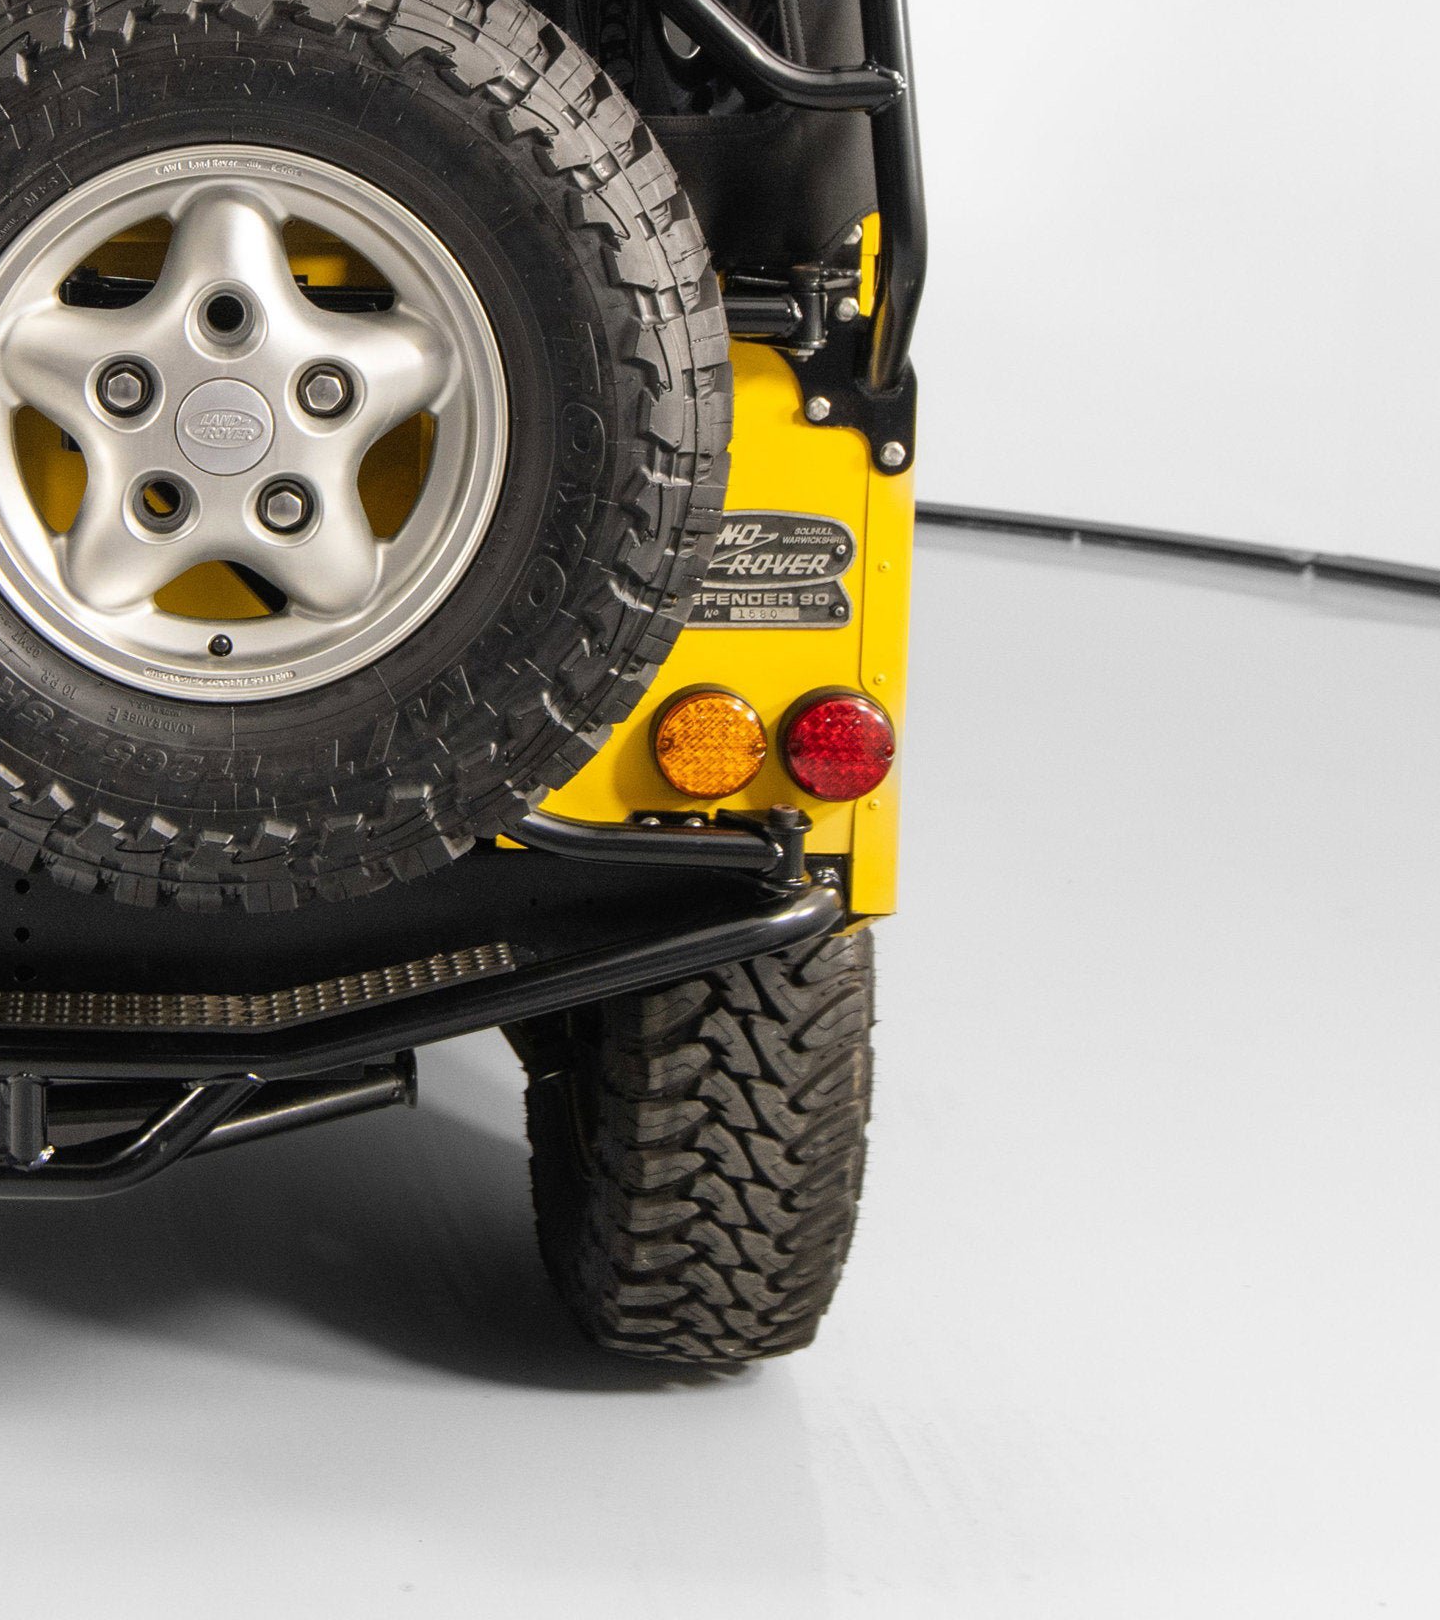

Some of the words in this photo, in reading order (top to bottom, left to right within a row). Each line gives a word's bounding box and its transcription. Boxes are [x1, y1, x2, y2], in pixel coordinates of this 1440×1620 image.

[203, 427, 254, 441] ROVER
[497, 314, 607, 642] TOYO
[717, 523, 762, 545] ND
[726, 553, 830, 575] ROVER
[692, 593, 793, 606] EFENDER
[800, 592, 829, 606] 90
